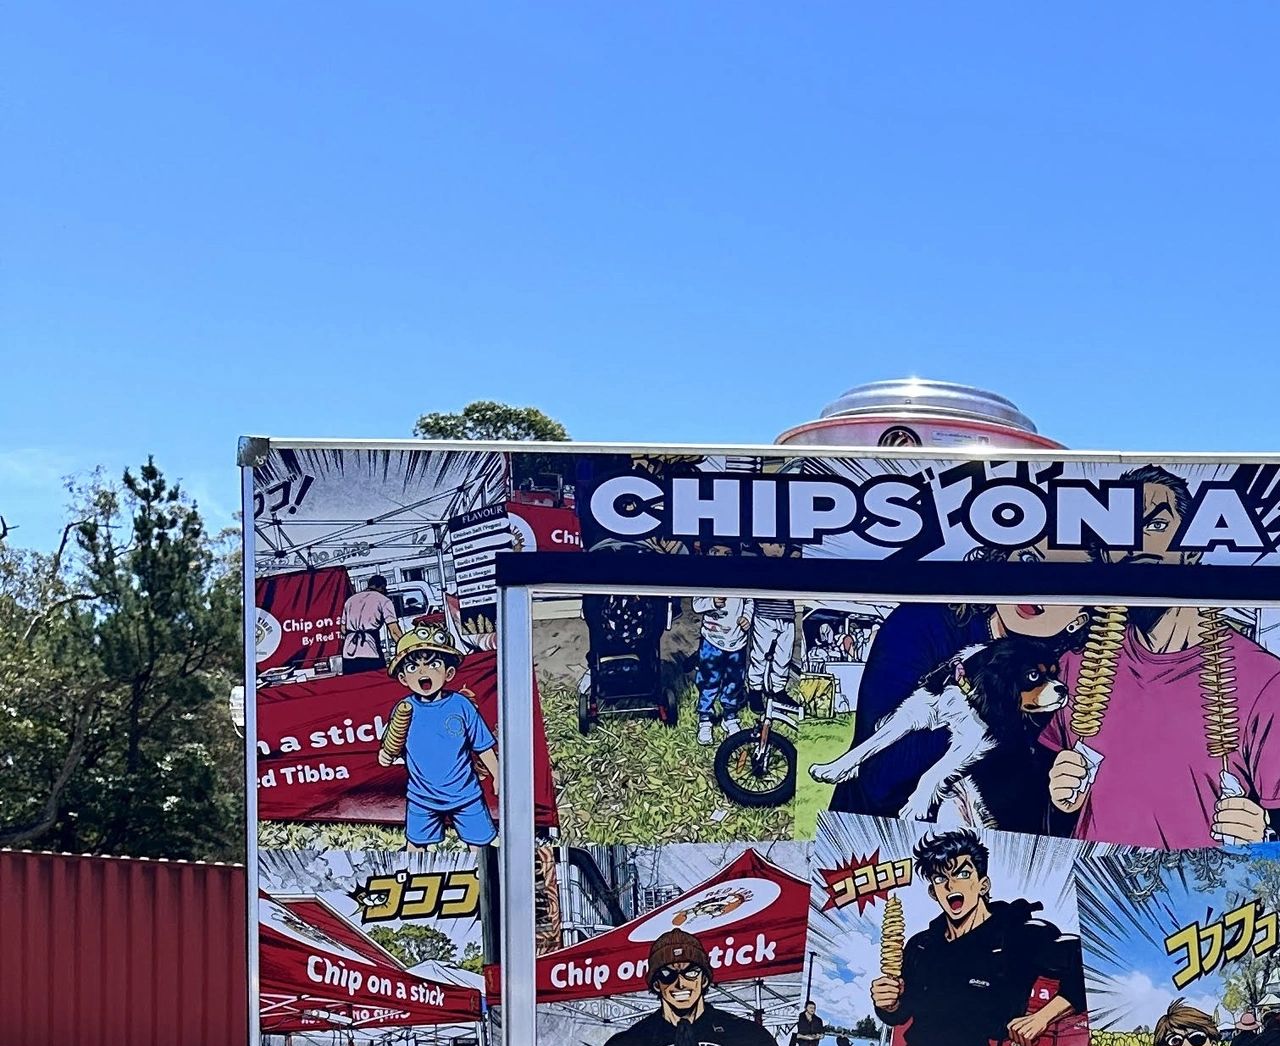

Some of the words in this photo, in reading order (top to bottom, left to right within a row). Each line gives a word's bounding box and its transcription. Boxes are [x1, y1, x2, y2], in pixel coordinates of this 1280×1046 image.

[590, 475, 923, 544] CHIPS
[969, 484, 1135, 547] ON
[1180, 488, 1264, 548] A
[283, 618, 313, 633] Chip
[316, 617, 333, 628] on
[302, 636, 313, 646] By
[316, 632, 334, 642] Red
[280, 735, 302, 753] a
[280, 763, 350, 786] Tibba
[307, 955, 363, 996] Chip
[367, 975, 392, 997] on
[396, 982, 407, 1000] a
[410, 982, 446, 1007] stick
[551, 957, 611, 991] Chip
